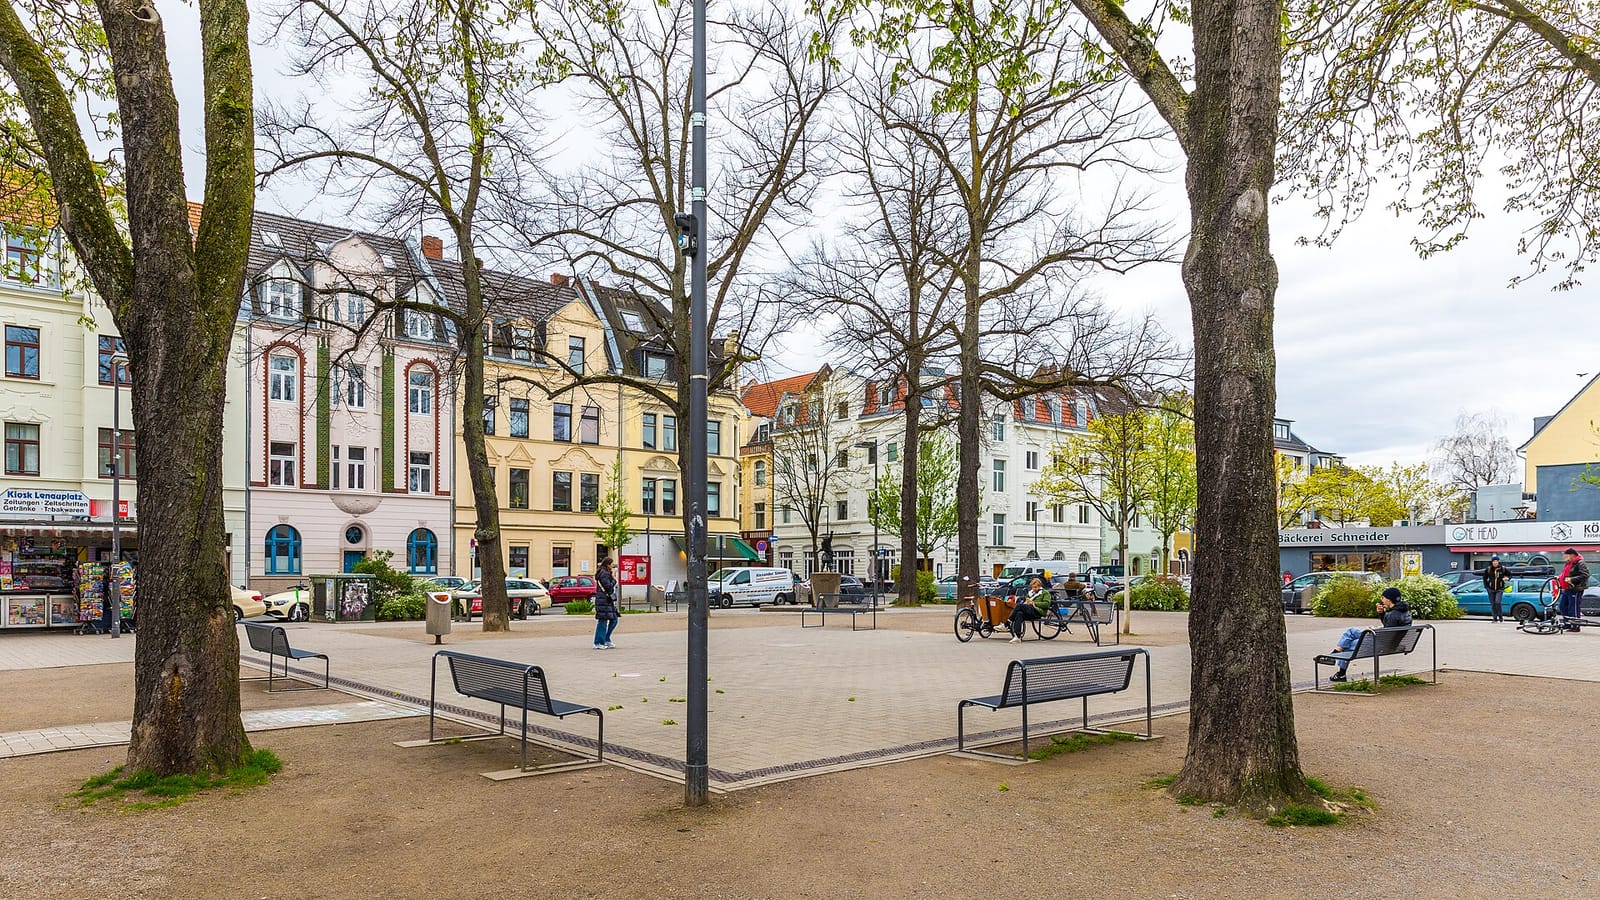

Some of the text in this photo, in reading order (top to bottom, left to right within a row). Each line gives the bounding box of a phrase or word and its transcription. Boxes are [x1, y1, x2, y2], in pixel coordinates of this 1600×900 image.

[7, 490, 82, 500] Kiosk Lenauplatz
[1279, 532, 1390, 542] Bäckerei Schneider
[1478, 527, 1498, 540] HEAD
